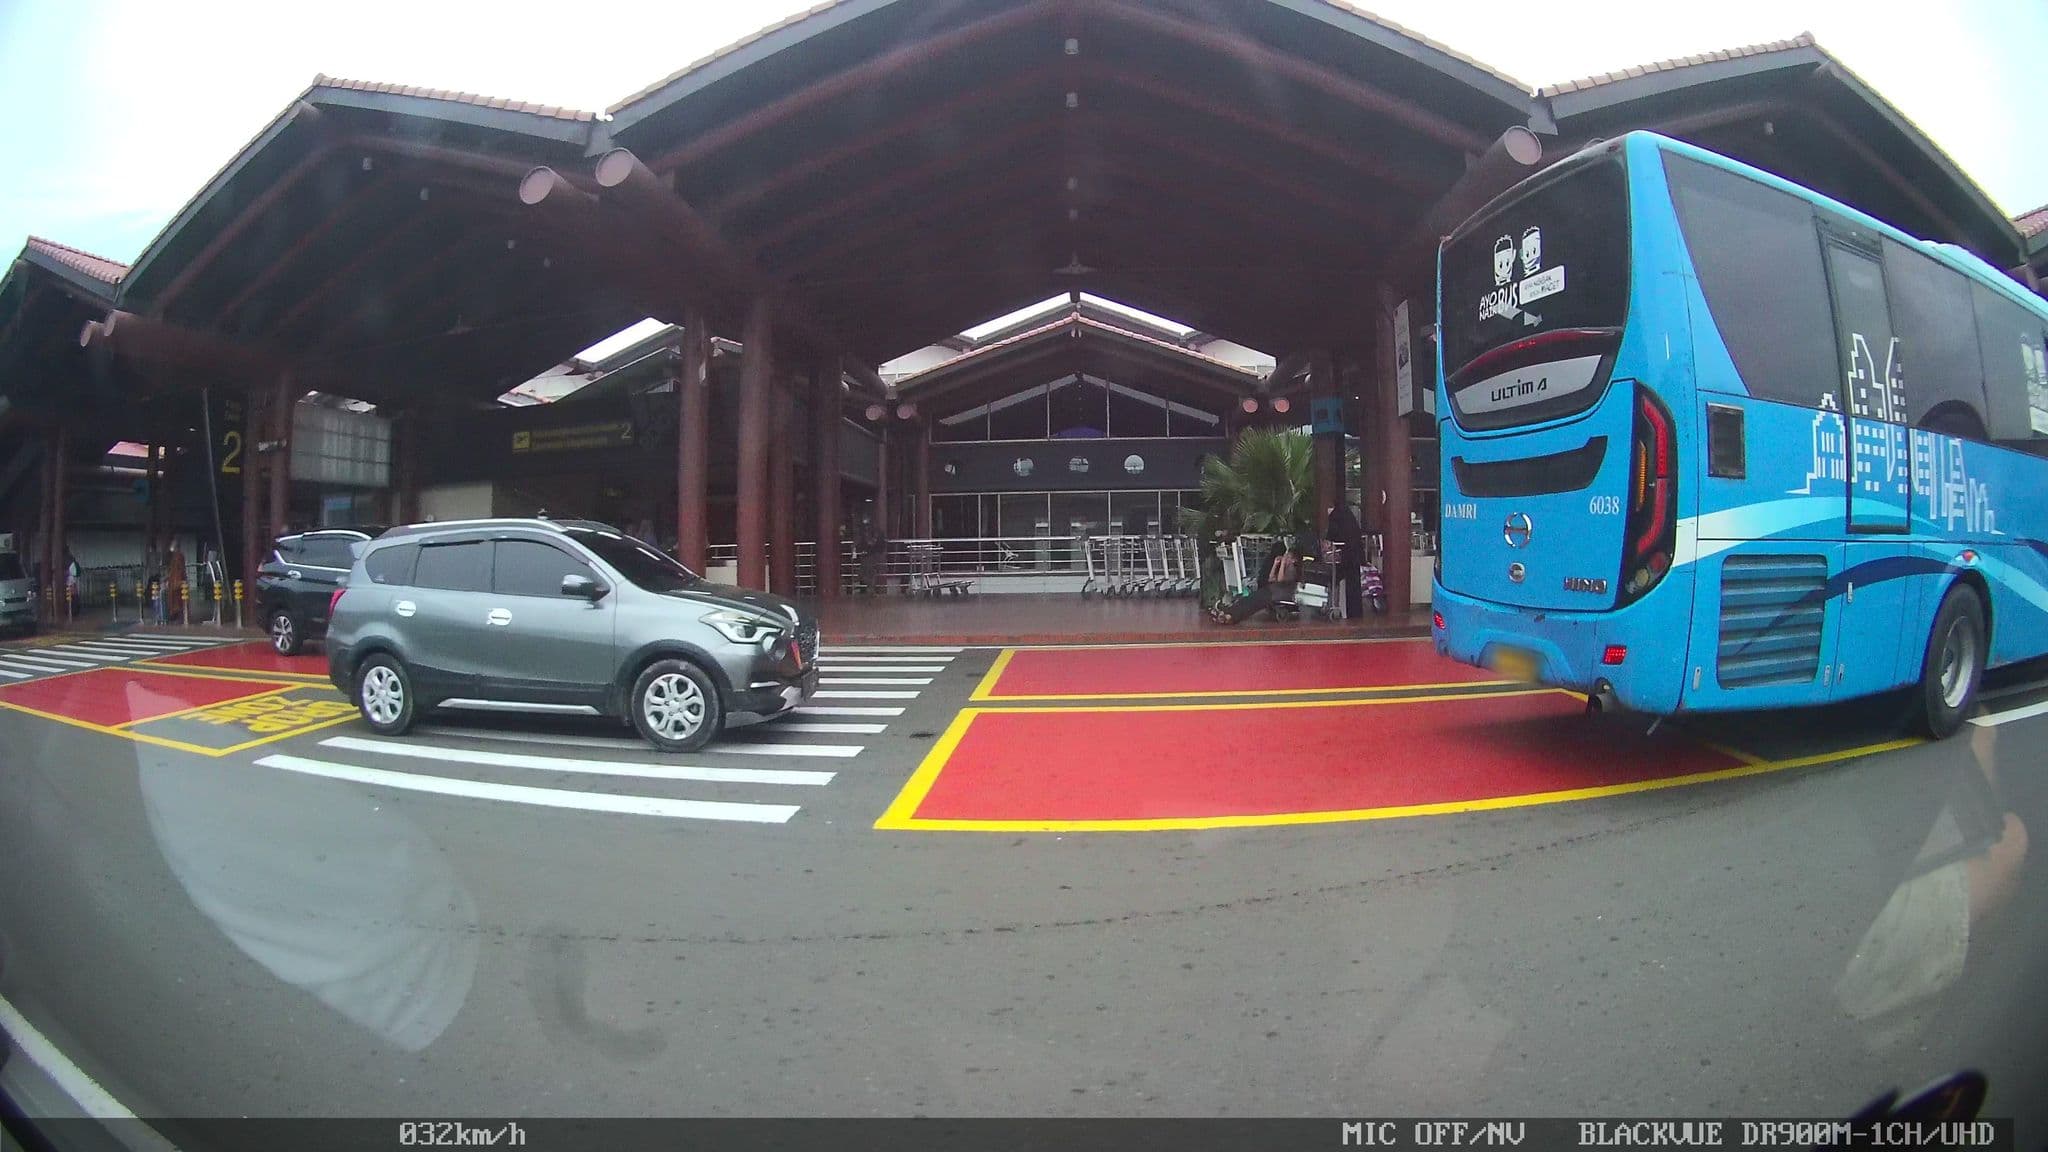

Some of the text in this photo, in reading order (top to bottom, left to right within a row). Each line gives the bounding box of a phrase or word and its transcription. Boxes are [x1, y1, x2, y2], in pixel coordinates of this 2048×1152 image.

[1480, 292, 1497, 309] AYO
[1498, 282, 1518, 313] BUS
[621, 423, 632, 440] 2
[222, 431, 241, 474] 2
[1445, 504, 1477, 520] DAMRI
[1589, 496, 1620, 515] 6038
